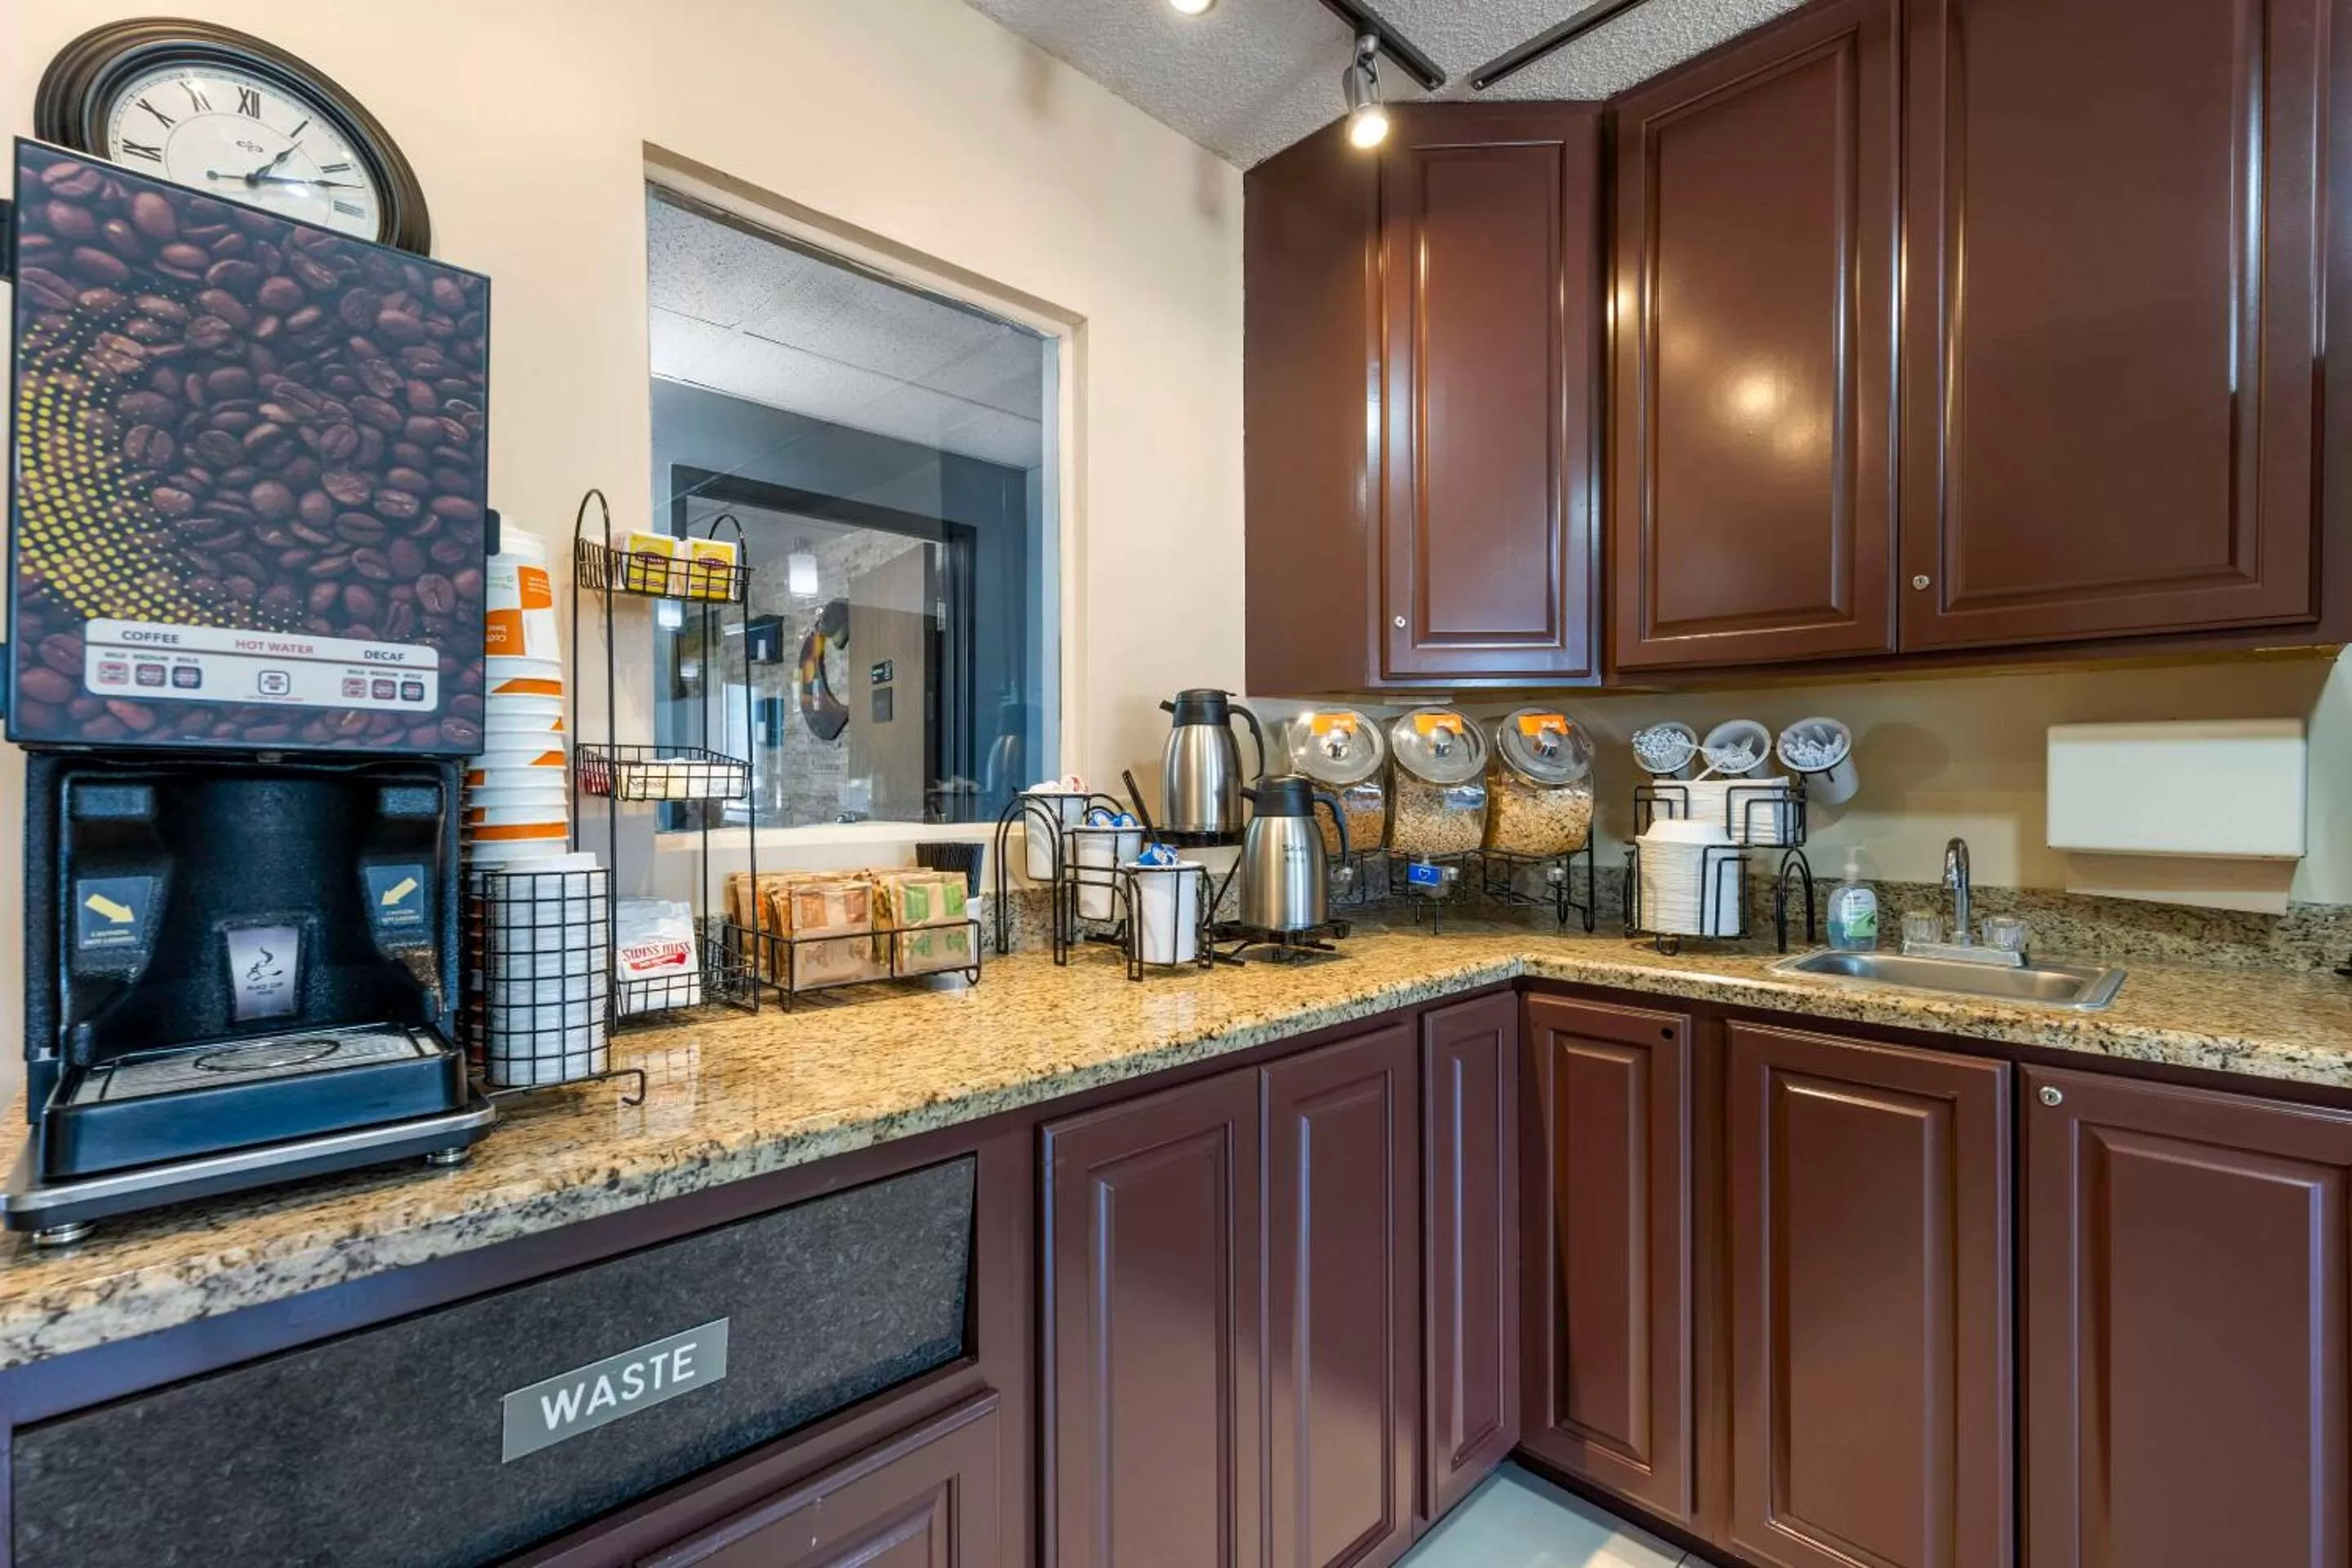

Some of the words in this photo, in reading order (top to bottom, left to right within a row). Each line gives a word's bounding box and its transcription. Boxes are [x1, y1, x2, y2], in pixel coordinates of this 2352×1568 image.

[238, 86, 261, 119] XII
[122, 630, 180, 644] COFFEE
[235, 639, 265, 650] HOT
[268, 642, 314, 655] WATER
[363, 649, 406, 662] DECAF
[622, 945, 660, 961] SWISS
[540, 1342, 698, 1431] WASTE
